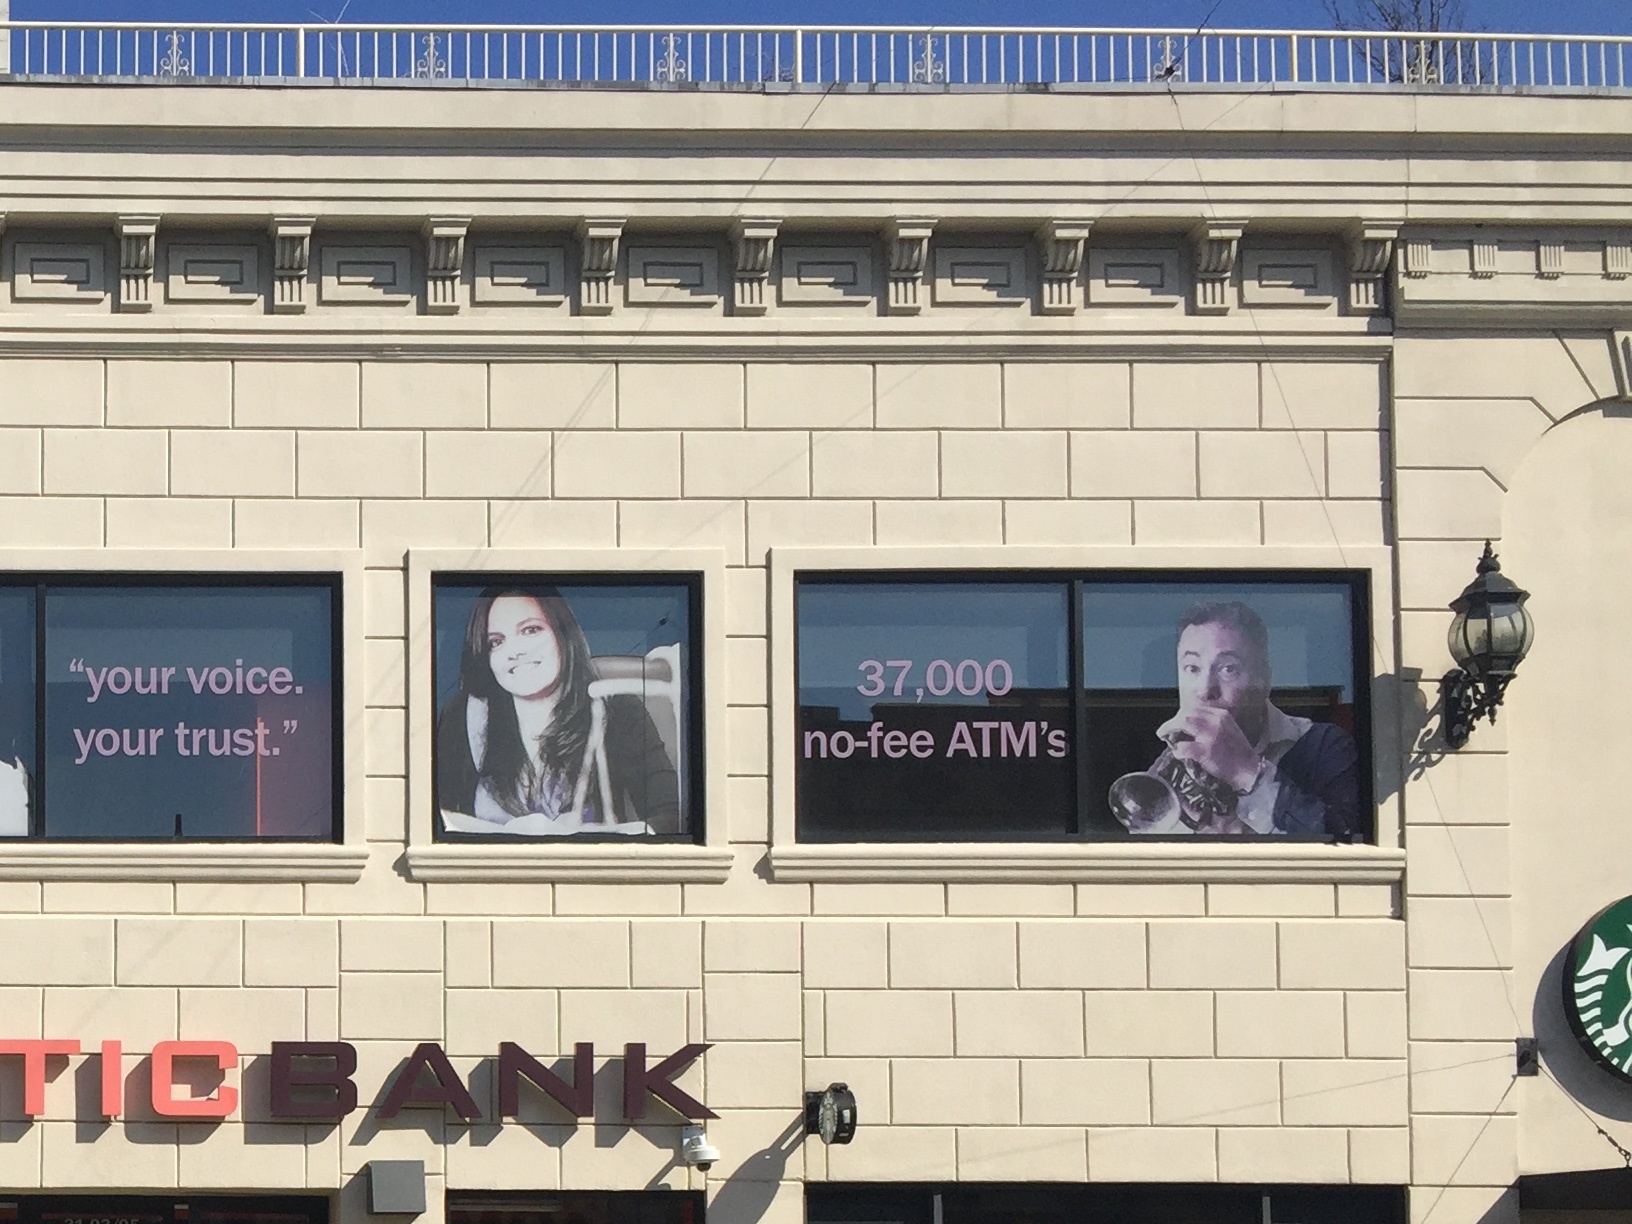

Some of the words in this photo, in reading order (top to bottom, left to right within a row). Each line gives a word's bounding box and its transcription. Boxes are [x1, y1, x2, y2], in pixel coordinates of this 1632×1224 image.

[69, 658, 174, 703] “your
[185, 658, 305, 696] voice.
[857, 660, 1013, 703] 37,000
[73, 729, 165, 764] your
[174, 720, 299, 757] trust.”
[804, 721, 935, 758] no-fee
